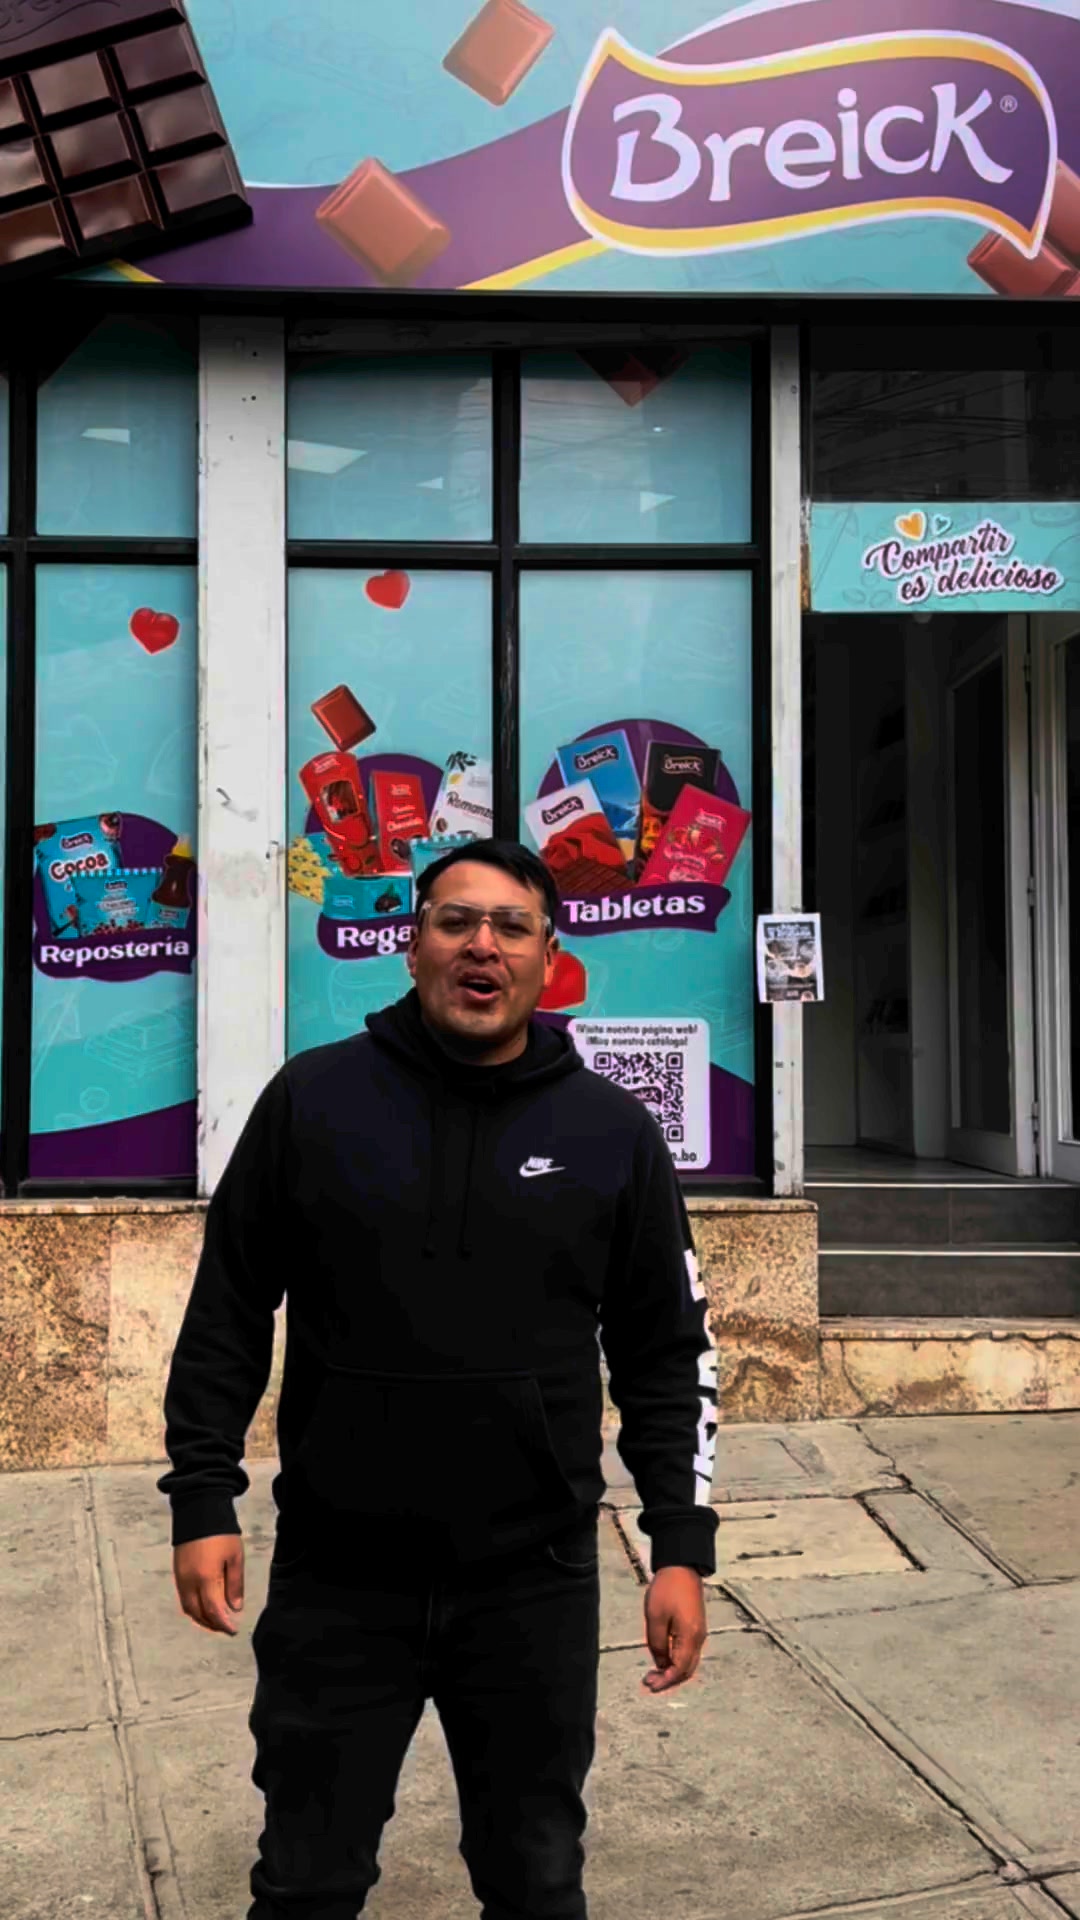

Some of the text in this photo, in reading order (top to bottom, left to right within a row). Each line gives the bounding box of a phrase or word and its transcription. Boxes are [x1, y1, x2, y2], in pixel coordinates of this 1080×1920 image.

[611, 83, 1013, 202] Breick
[865, 522, 1009, 575] Compartir
[901, 557, 1058, 600] es delicioso
[51, 853, 109, 880] Cocoa
[563, 894, 706, 923] Tabletas
[40, 936, 190, 968] Repostería
[337, 925, 412, 955] Rega
